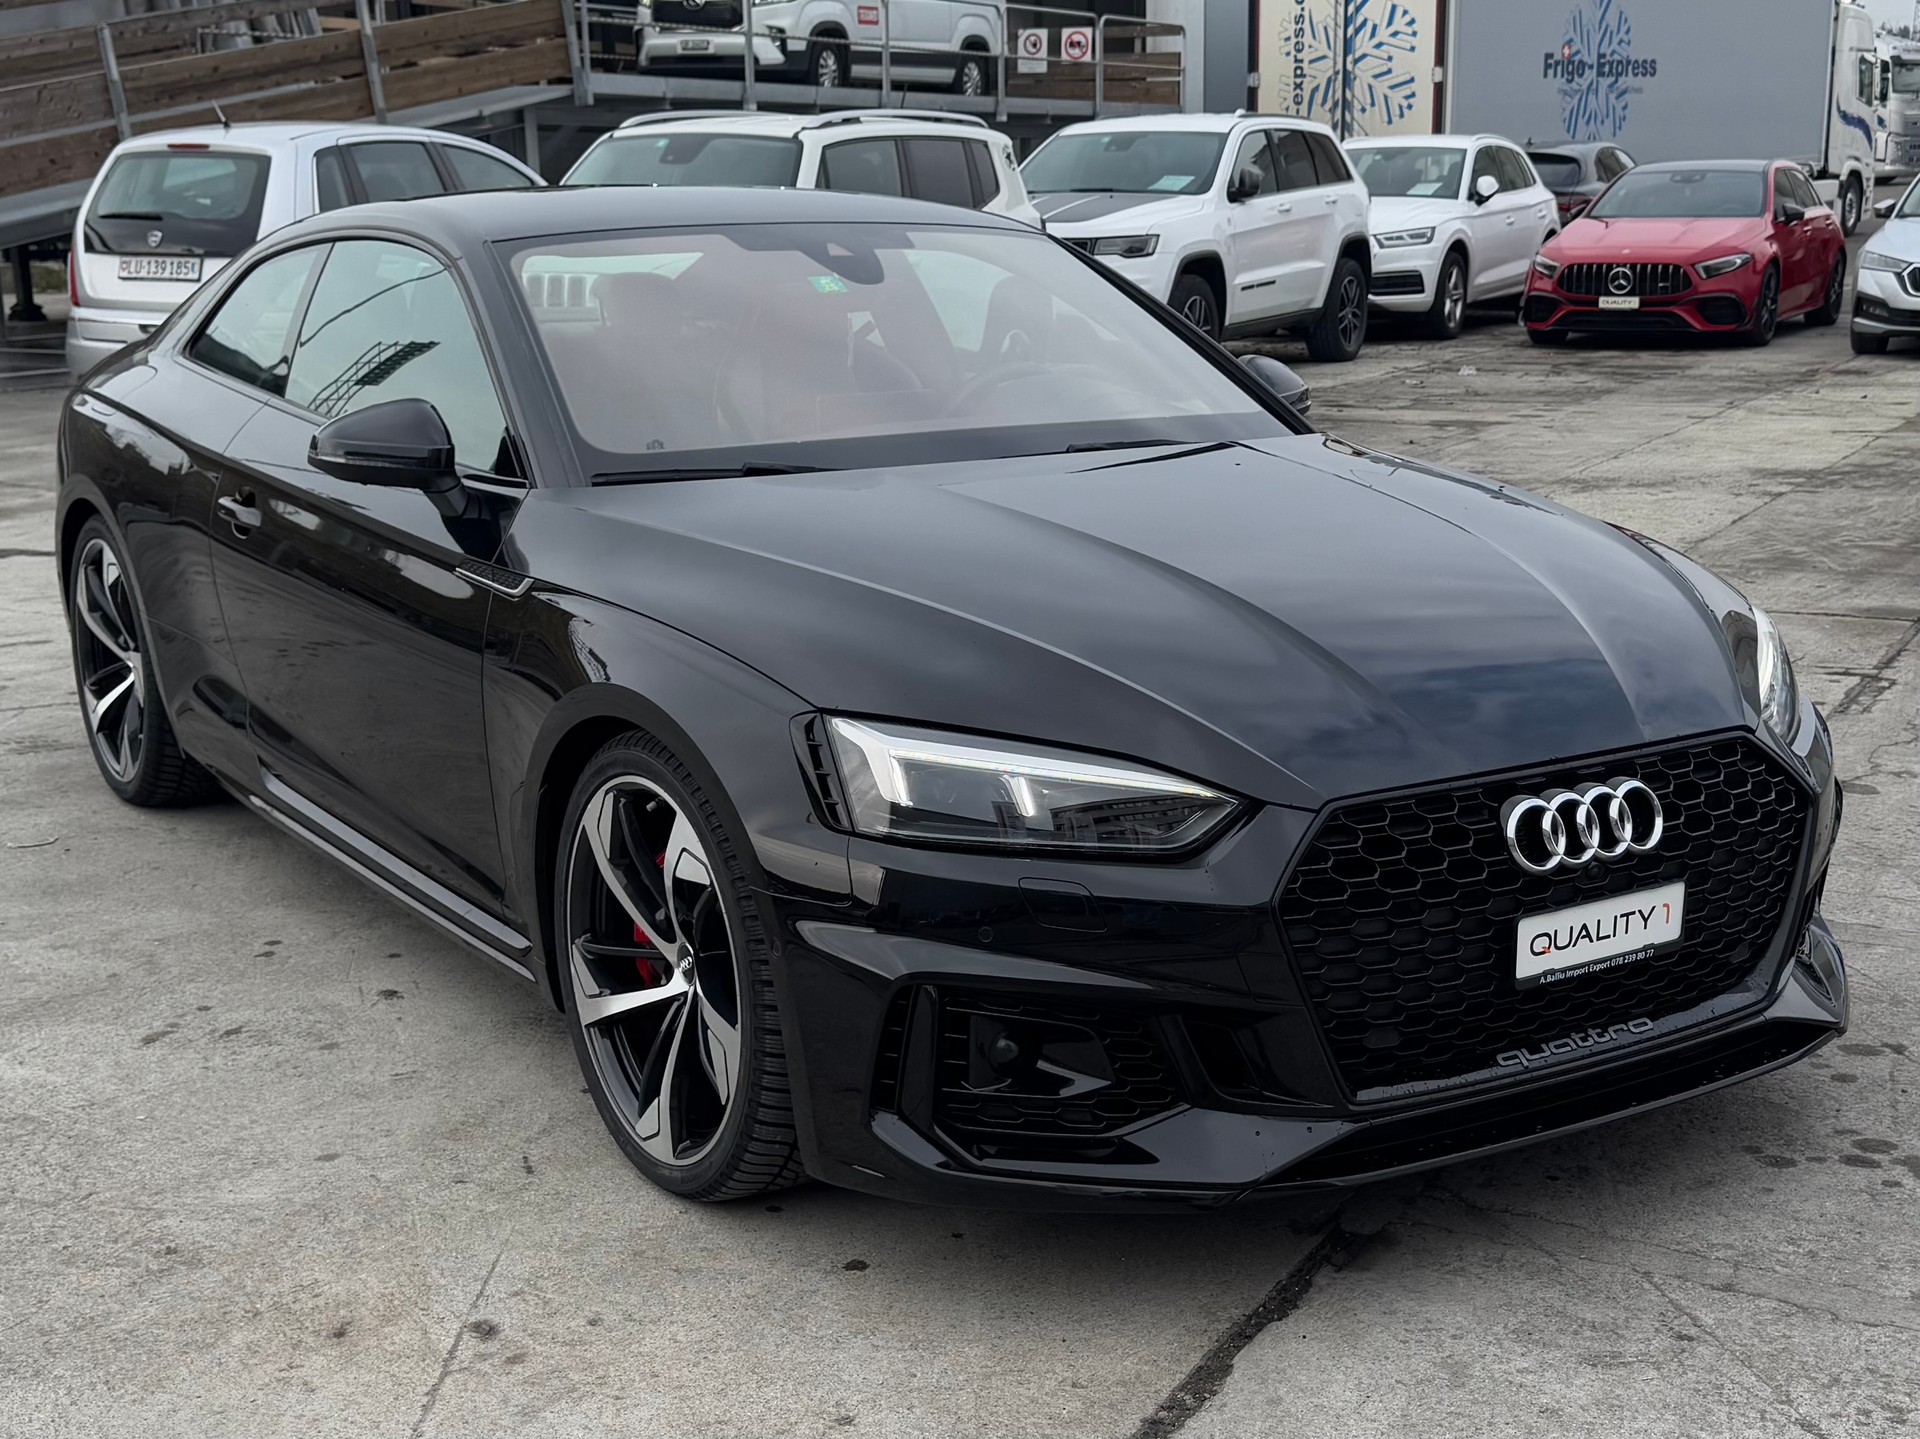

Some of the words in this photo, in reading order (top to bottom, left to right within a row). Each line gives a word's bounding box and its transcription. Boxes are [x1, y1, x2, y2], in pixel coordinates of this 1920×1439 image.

[1529, 905, 1656, 956] QUALITY
[1663, 903, 1672, 924] 1
[1566, 965, 1588, 978] Import
[1590, 960, 1610, 972] Export
[1611, 956, 1624, 967] 078
[1624, 953, 1637, 964] 239
[1637, 951, 1646, 960] 80
[1646, 949, 1655, 958] 77
[1496, 1017, 1654, 1068] quattro
